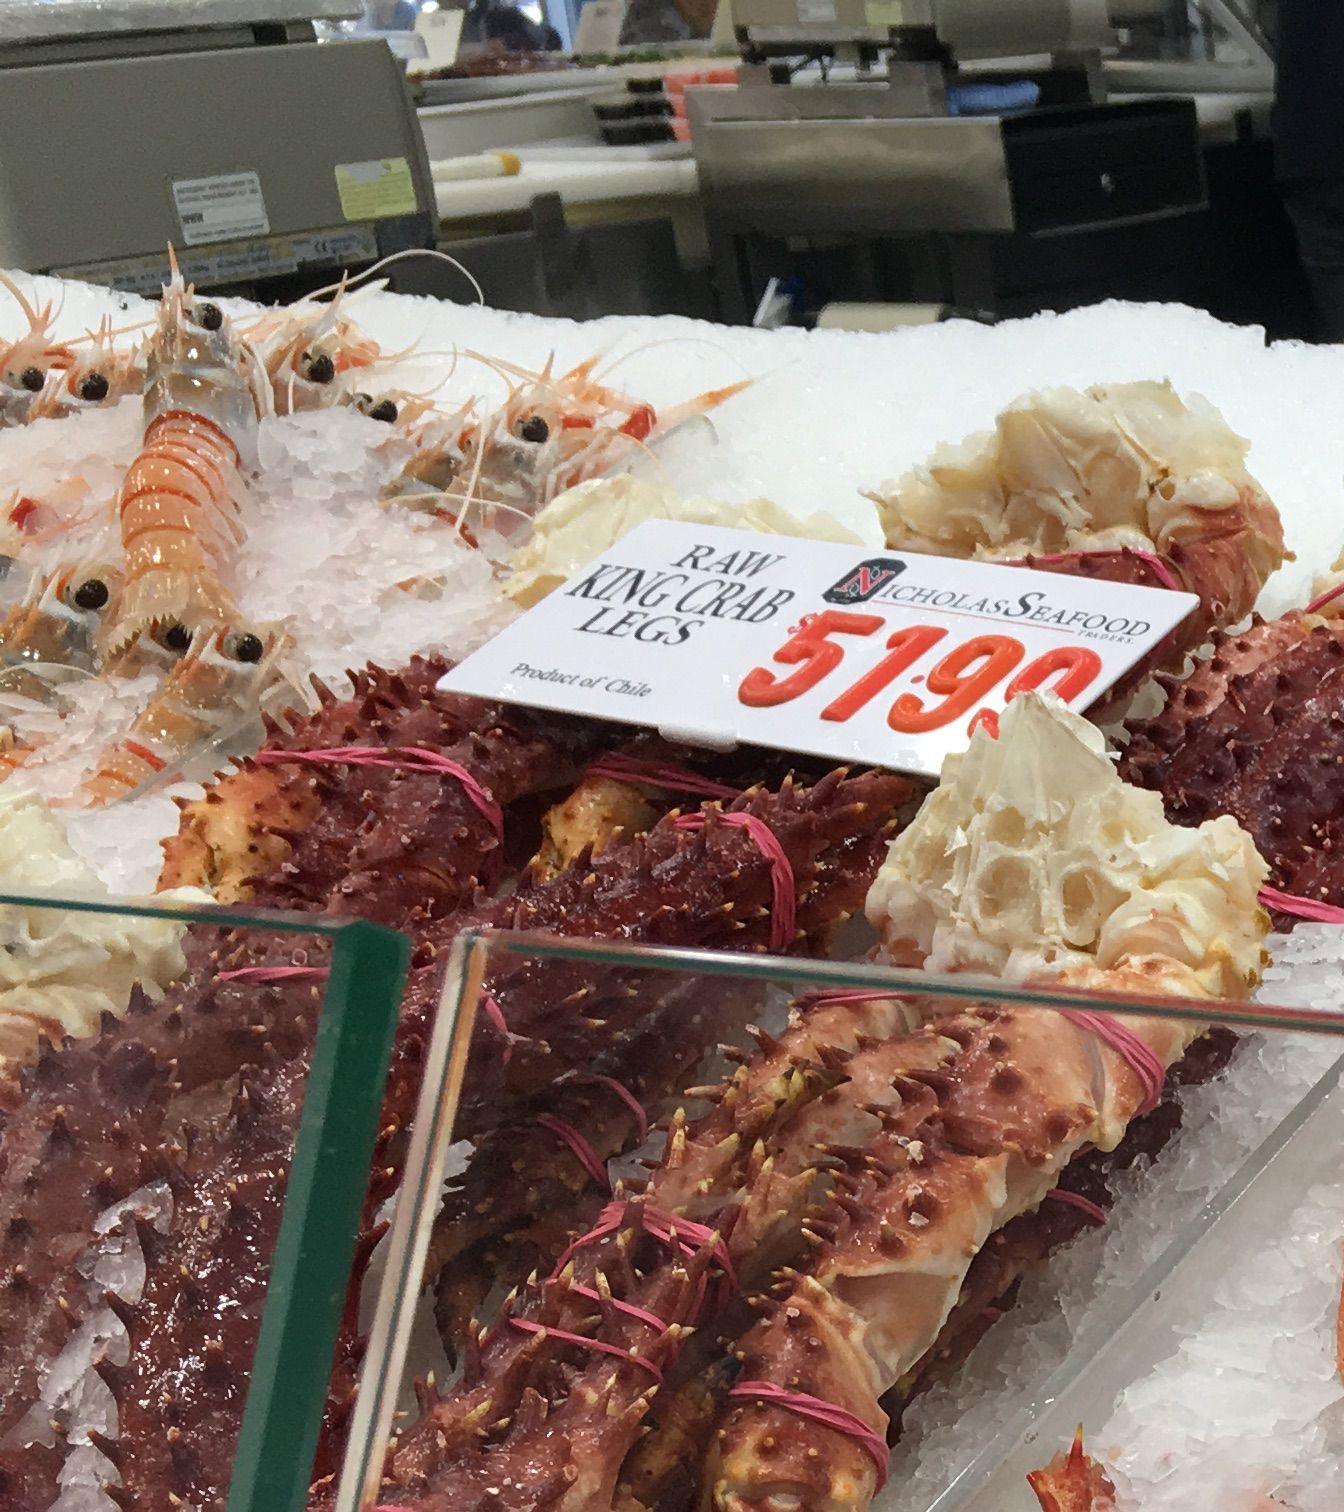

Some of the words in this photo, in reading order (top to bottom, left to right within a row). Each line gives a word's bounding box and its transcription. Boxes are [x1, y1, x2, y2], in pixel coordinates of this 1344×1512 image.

[669, 544, 787, 578] RAW
[564, 564, 689, 608] KING
[674, 579, 796, 624] CRAB
[573, 606, 705, 646] LEGS
[510, 662, 581, 686] Product
[579, 676, 608, 689] of
[605, 678, 653, 698] Chile
